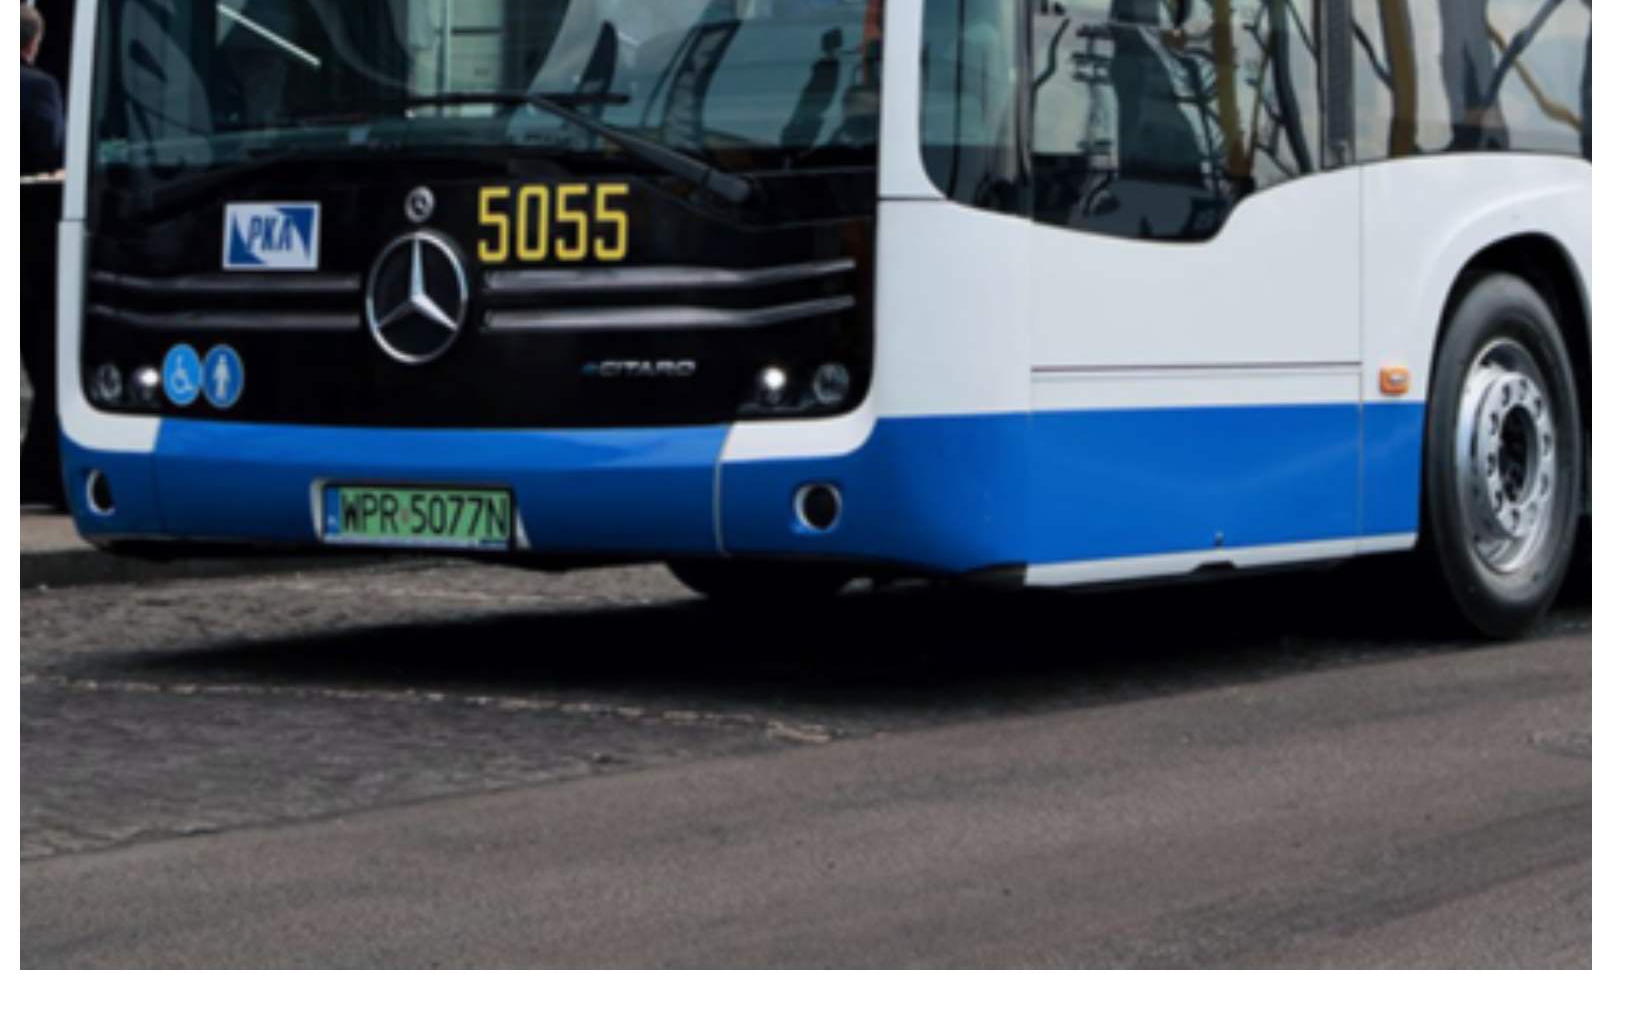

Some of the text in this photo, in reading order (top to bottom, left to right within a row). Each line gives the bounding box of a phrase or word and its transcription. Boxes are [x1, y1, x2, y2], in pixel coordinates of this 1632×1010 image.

[247, 214, 295, 252] PKA
[477, 184, 630, 262] 5055
[342, 492, 508, 538] WPR 5077N
